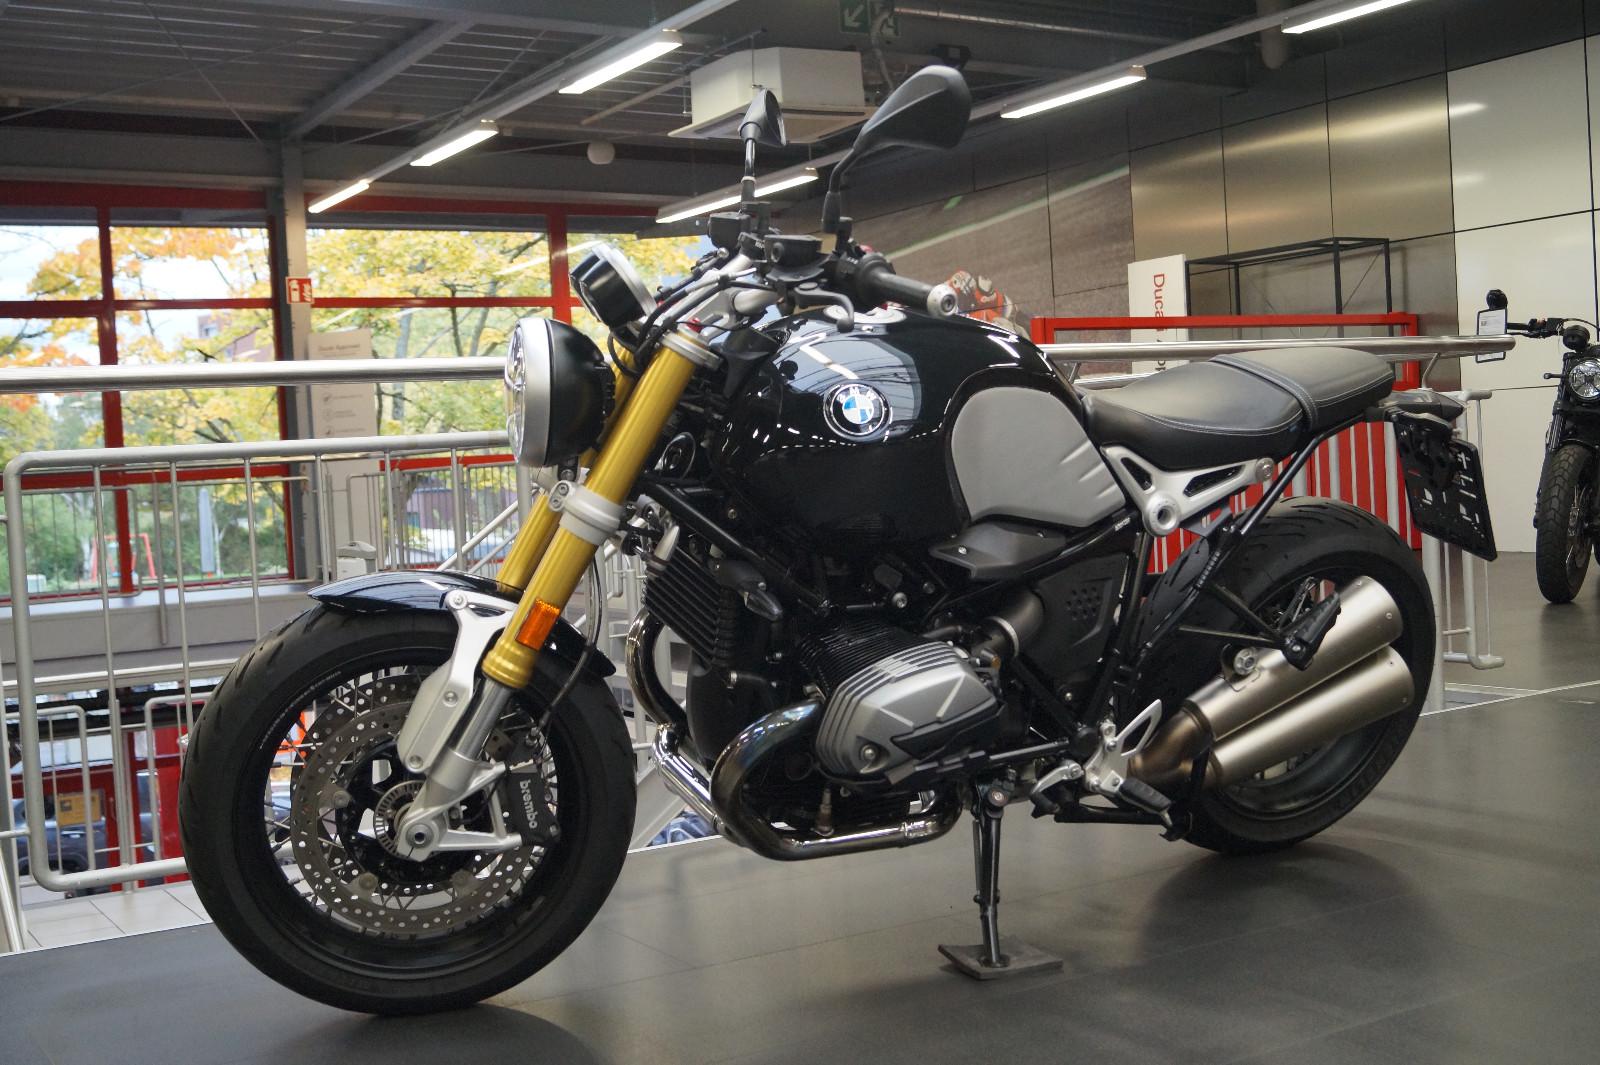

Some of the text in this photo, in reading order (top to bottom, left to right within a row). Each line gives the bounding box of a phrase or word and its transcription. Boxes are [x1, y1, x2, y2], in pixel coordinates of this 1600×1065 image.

[1153, 272, 1167, 332] Ducai
[836, 386, 877, 404] BMW
[519, 779, 538, 829] brembo
